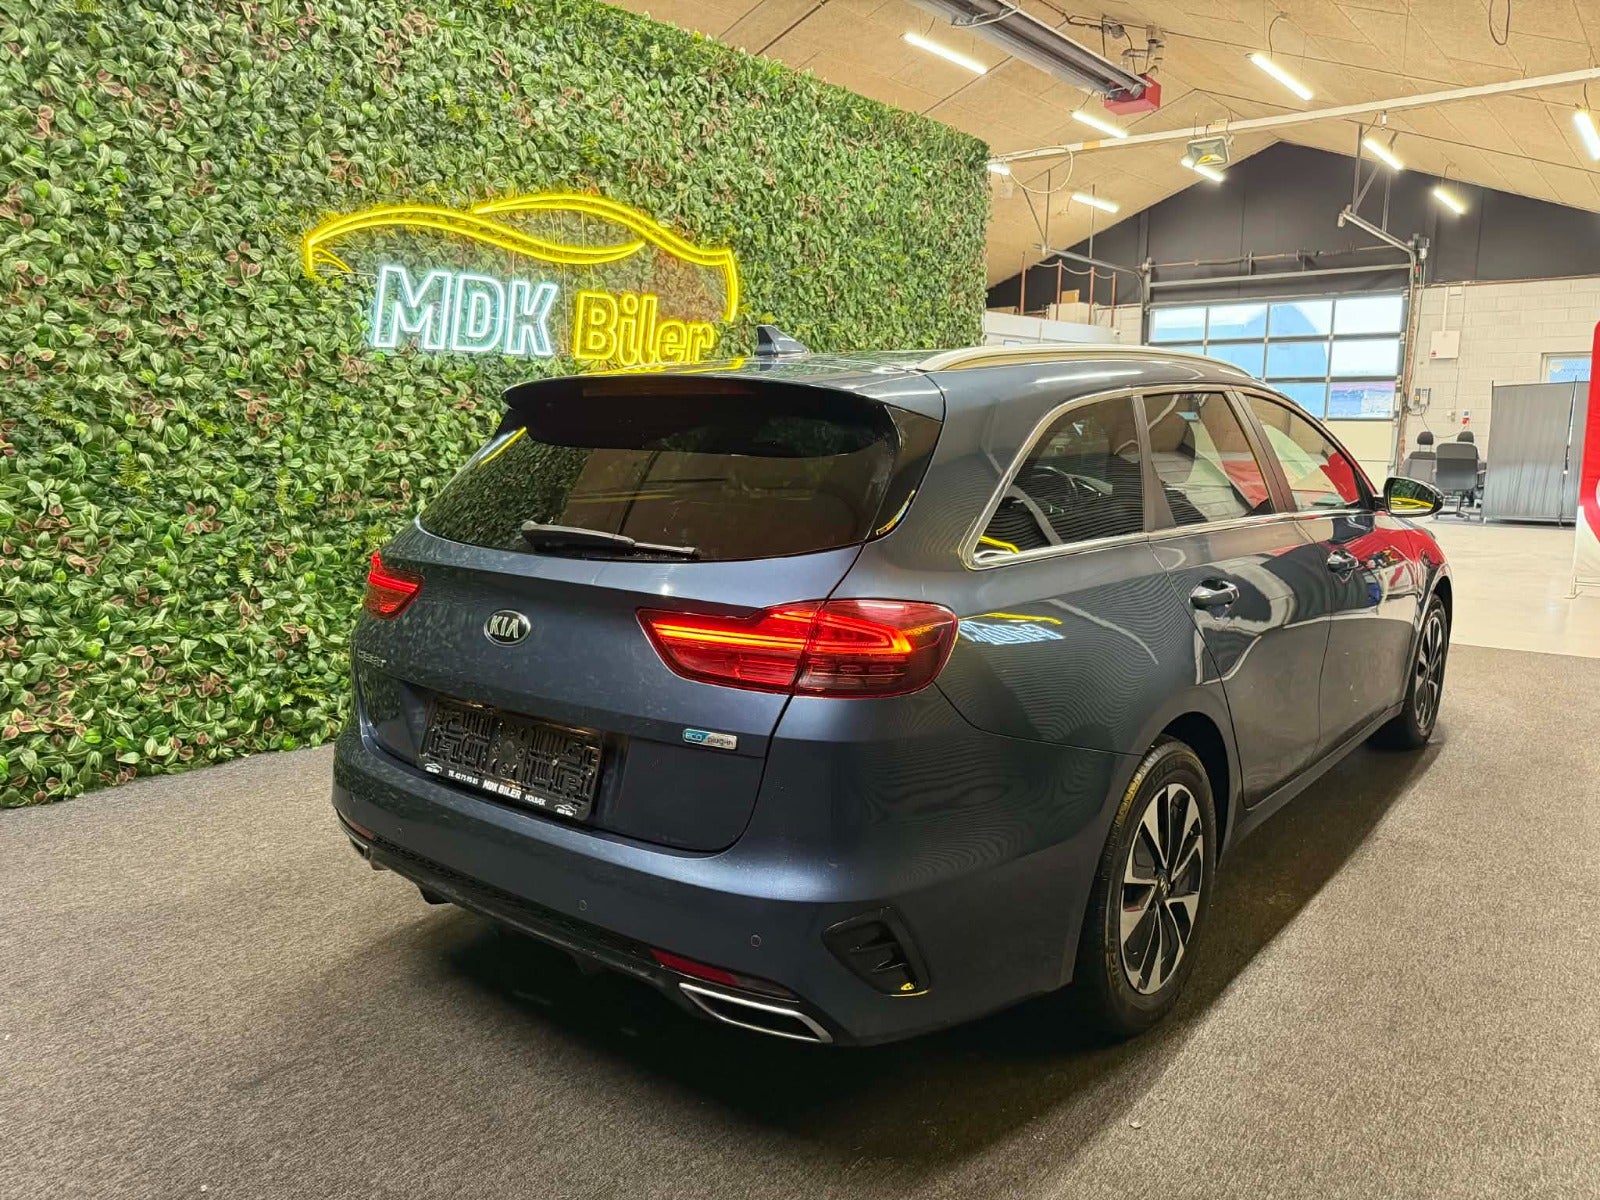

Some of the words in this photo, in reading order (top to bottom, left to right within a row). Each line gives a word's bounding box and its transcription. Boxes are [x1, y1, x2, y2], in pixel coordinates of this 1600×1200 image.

[372, 264, 558, 357] MDK
[573, 290, 715, 366] Biler
[490, 615, 519, 639] KIA
[498, 784, 522, 800] BILER
